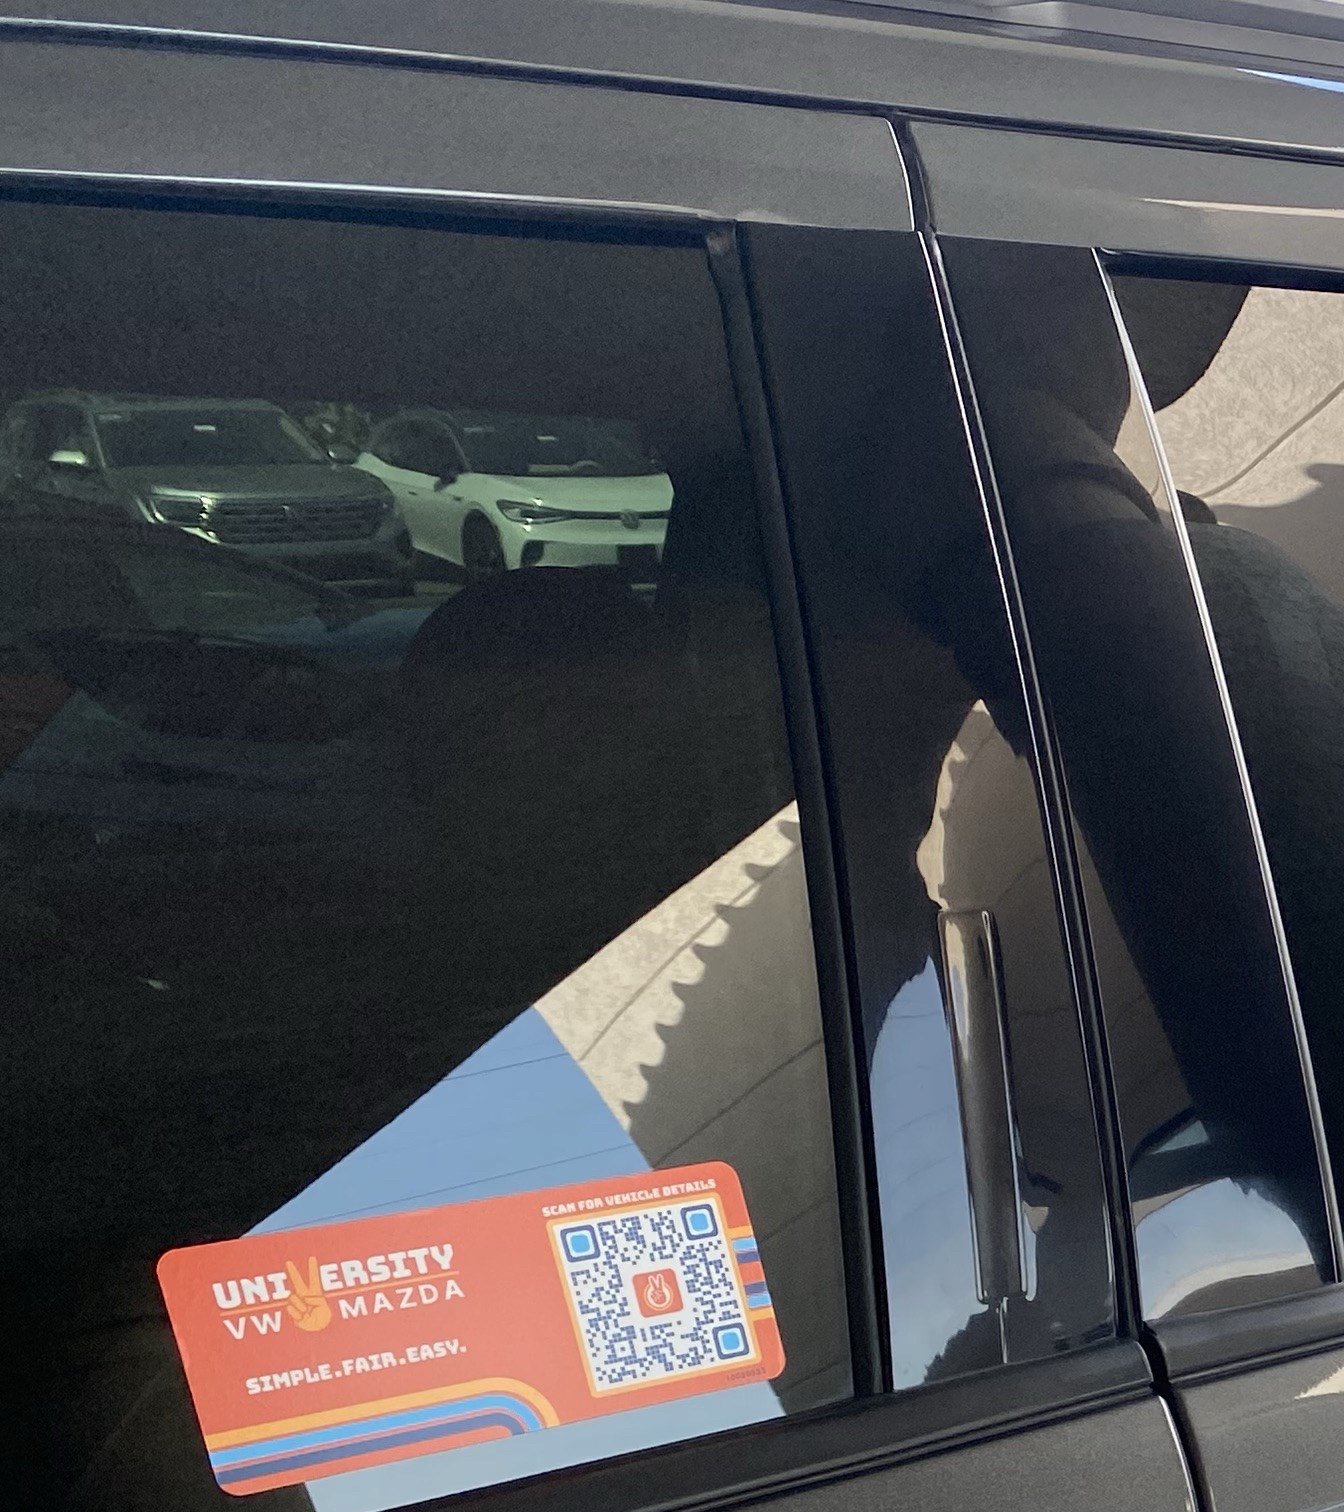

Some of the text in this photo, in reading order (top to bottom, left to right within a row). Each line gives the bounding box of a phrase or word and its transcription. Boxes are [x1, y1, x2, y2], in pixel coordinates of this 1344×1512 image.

[541, 1178, 717, 1218] SCAN FOR VEHICLE DETAILS
[223, 1279, 466, 1340] VW MAZDA
